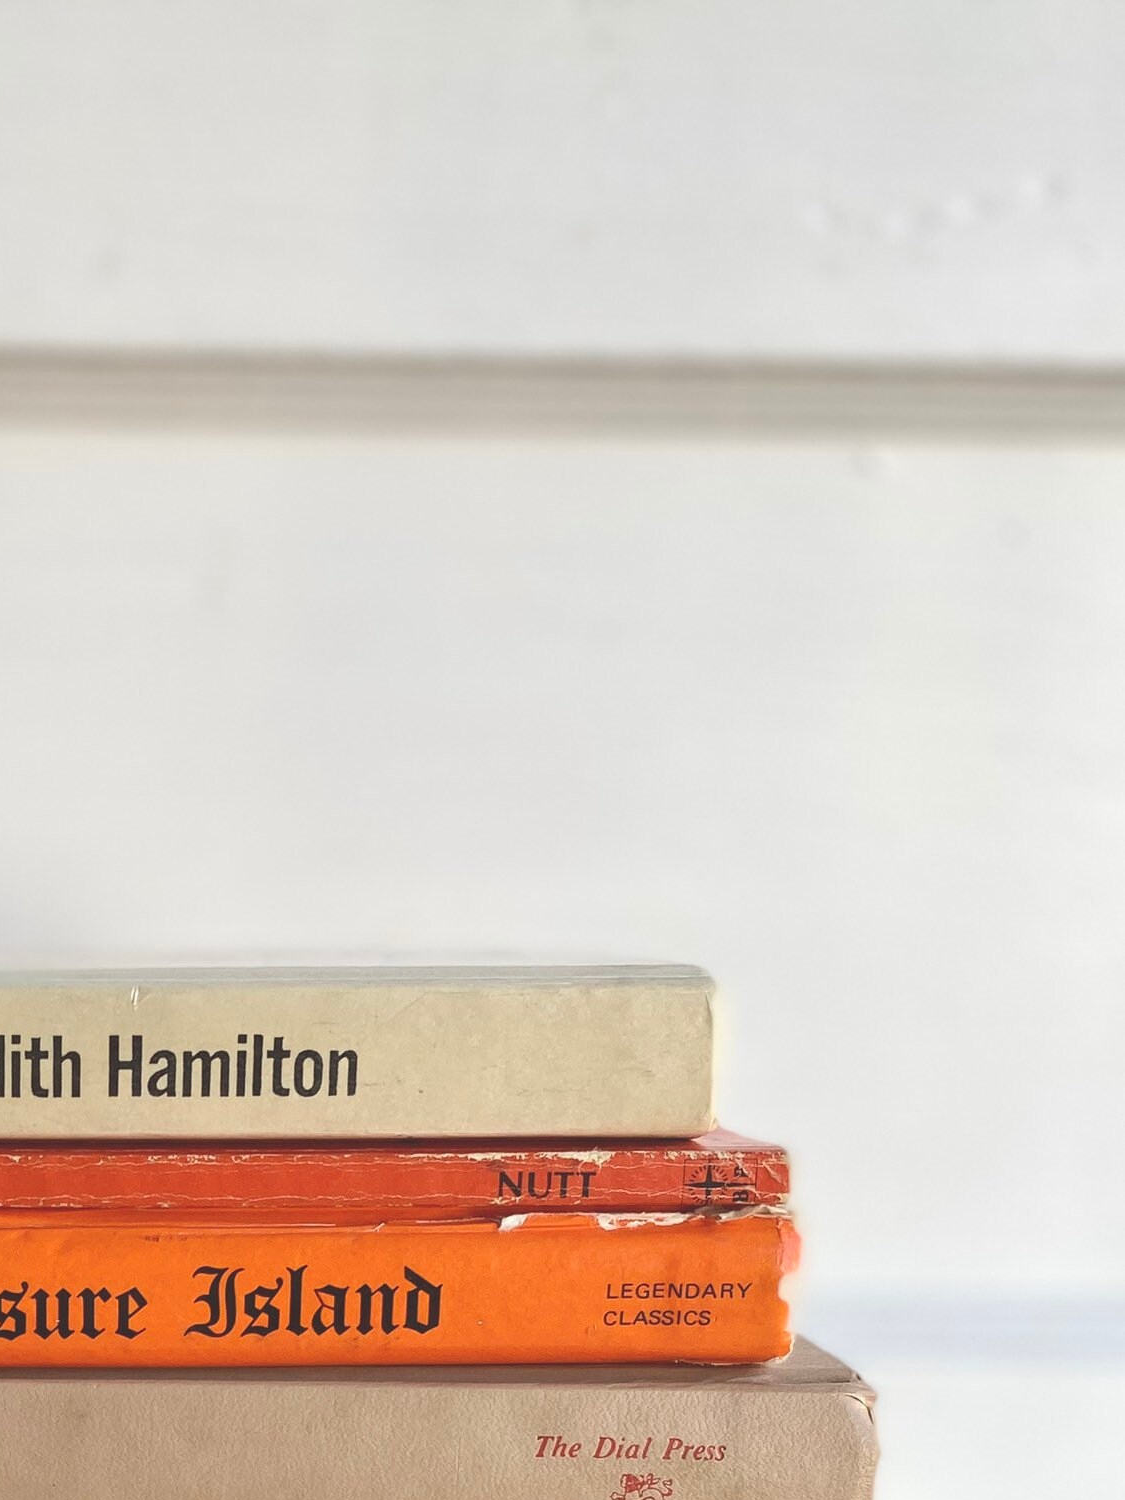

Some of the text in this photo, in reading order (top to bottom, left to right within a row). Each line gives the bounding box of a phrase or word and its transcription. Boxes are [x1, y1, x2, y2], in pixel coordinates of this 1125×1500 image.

[108, 1034, 358, 1098] Hamilton
[498, 1171, 597, 1198] NUTT
[183, 1264, 443, 1338] Island
[606, 1282, 753, 1300] LEGENDARY
[603, 1309, 712, 1327] CLASSICS
[535, 1435, 727, 1461] The Dial Press
